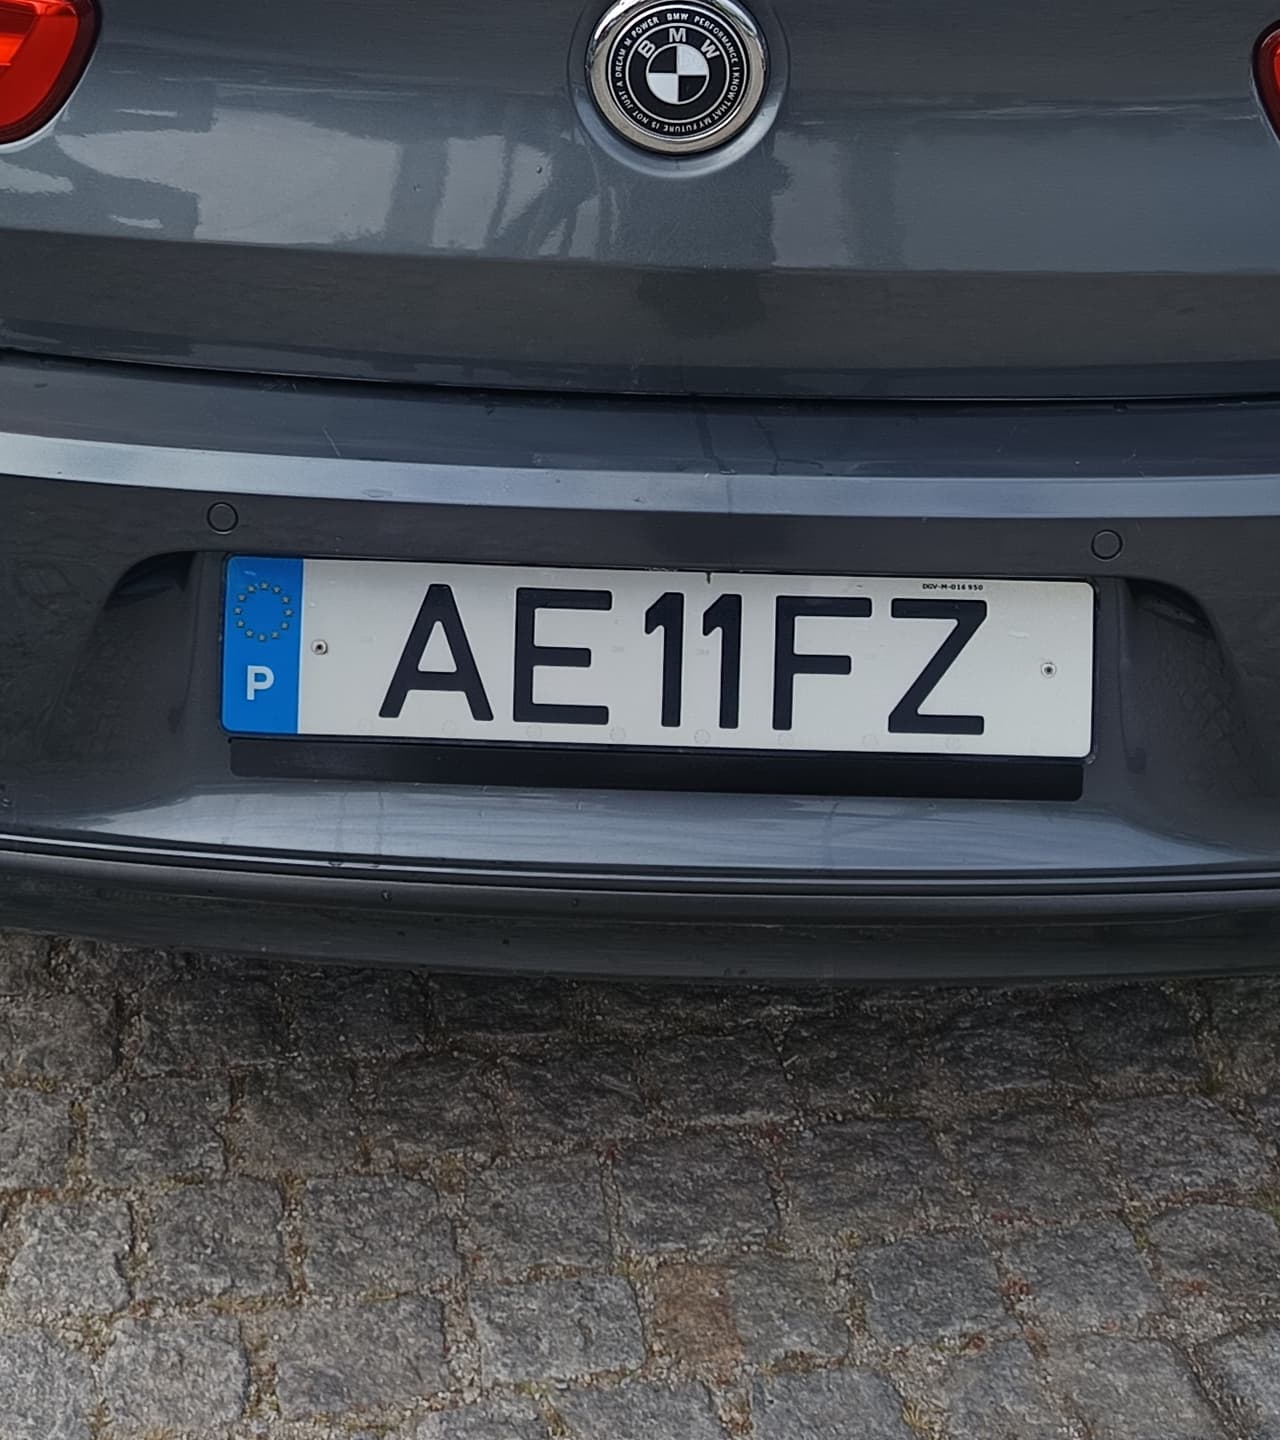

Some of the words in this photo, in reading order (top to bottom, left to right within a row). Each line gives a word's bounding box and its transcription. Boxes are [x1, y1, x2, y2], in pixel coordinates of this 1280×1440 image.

[631, 16, 660, 38] POWER
[666, 12, 689, 21] BMW
[637, 27, 720, 59] BMW
[694, 15, 739, 64] PERFORMANCE
[727, 72, 740, 101] KNOW
[712, 100, 731, 120] THAT
[246, 665, 275, 701] P
